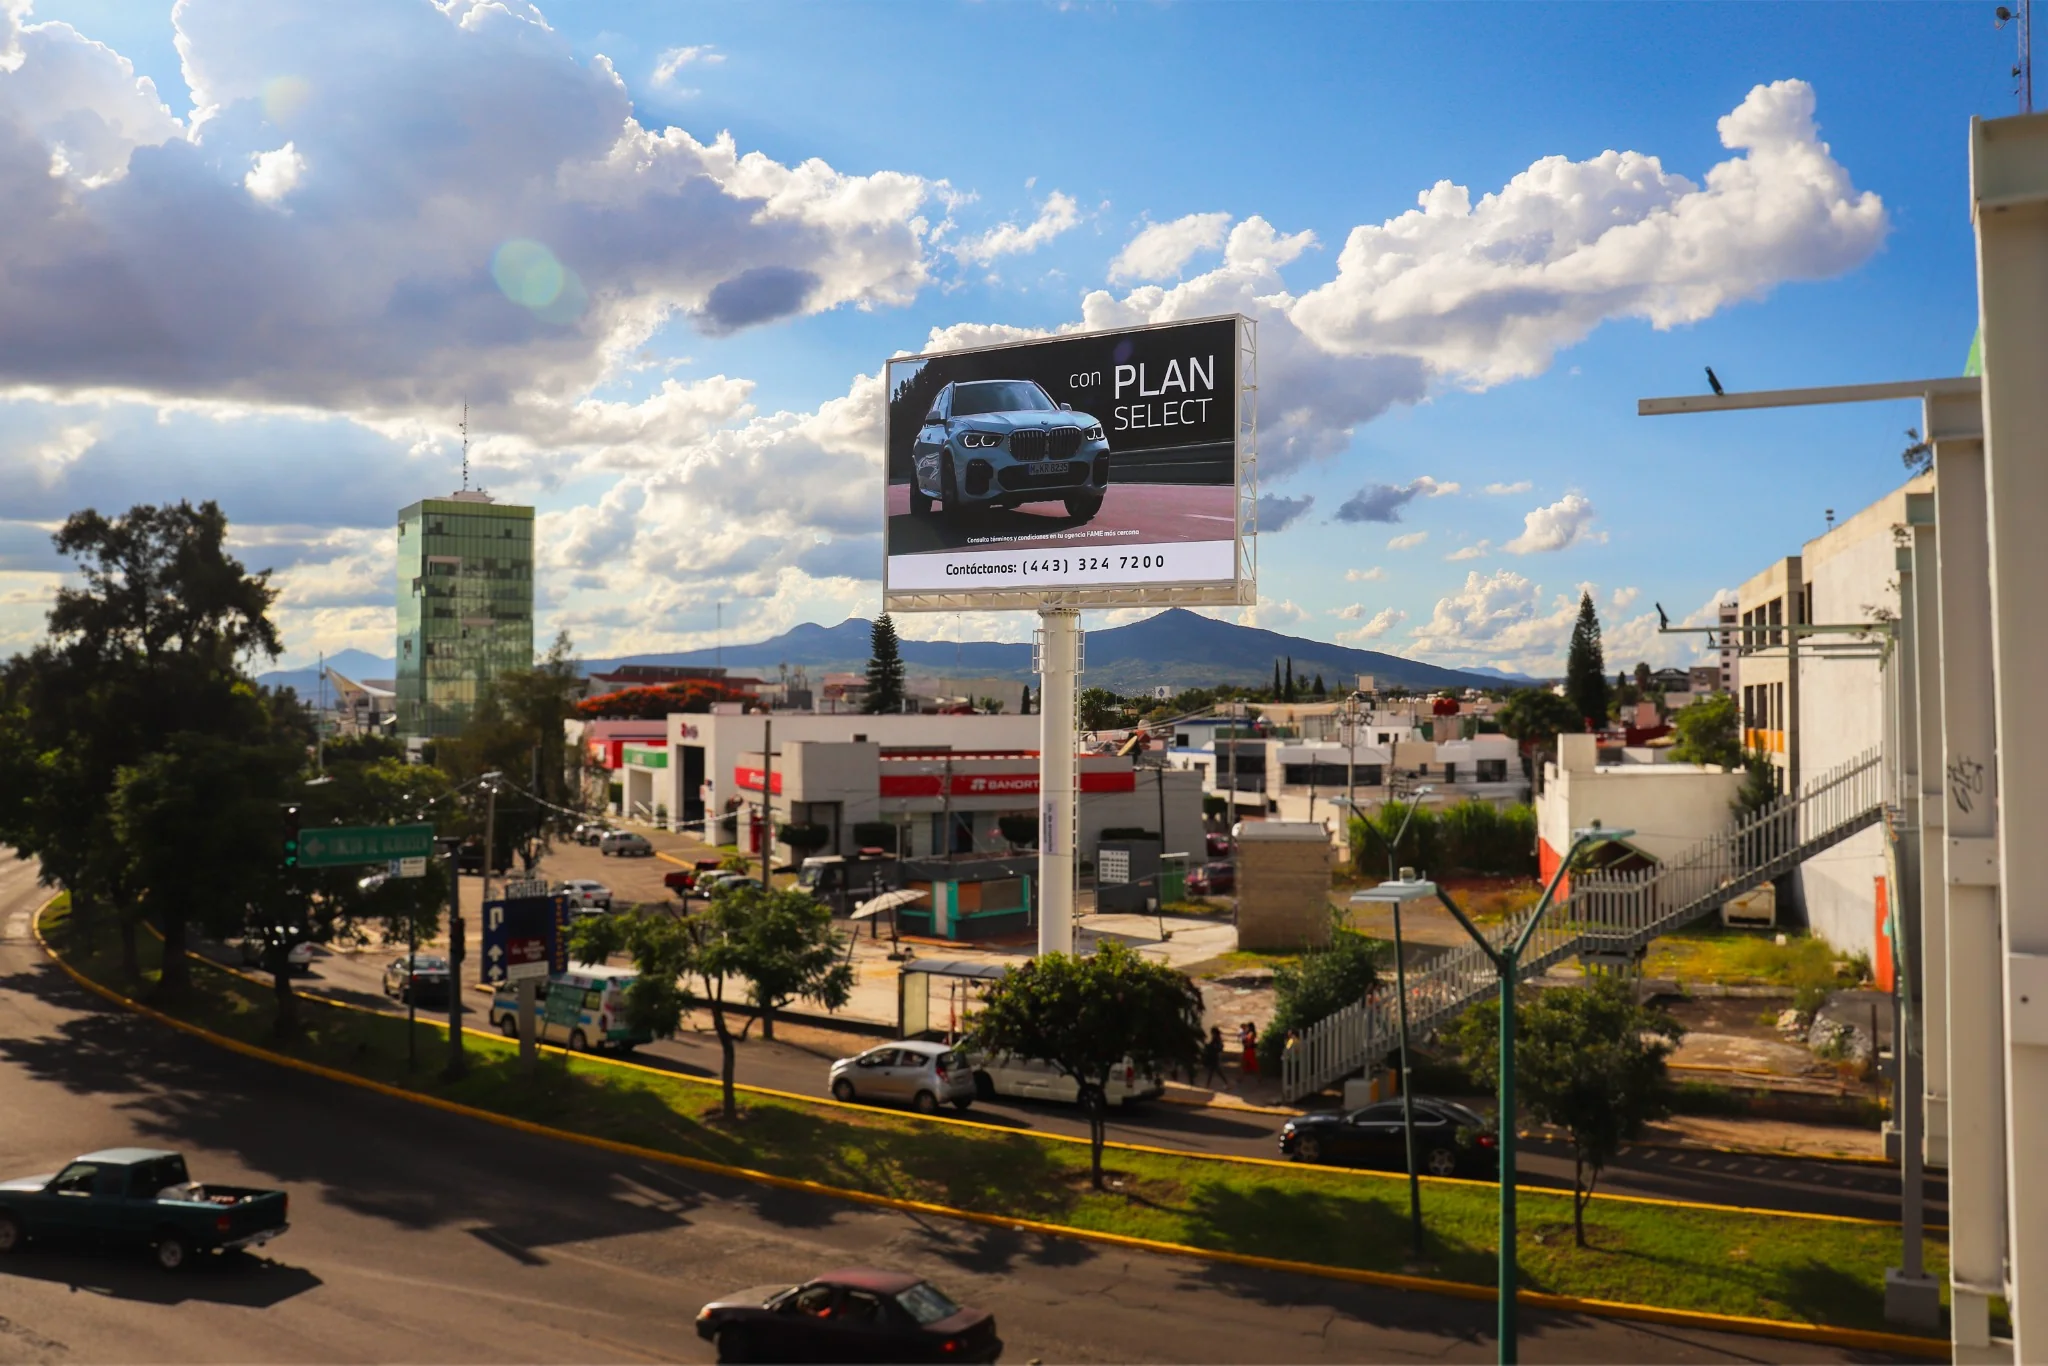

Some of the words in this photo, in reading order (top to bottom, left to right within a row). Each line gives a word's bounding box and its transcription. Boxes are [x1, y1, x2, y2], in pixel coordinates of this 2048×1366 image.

[1069, 371, 1101, 389] con
[1114, 355, 1214, 400] PLAN
[1114, 398, 1213, 431] SELECT
[1018, 533, 1049, 541] condiciones
[1064, 531, 1086, 540] agencia
[1086, 530, 1104, 538] FAME
[946, 562, 1017, 576] Contáctanos:
[1078, 557, 1109, 571] 324
[1119, 554, 1165, 569] 7200
[987, 779, 1040, 791] BANORT
